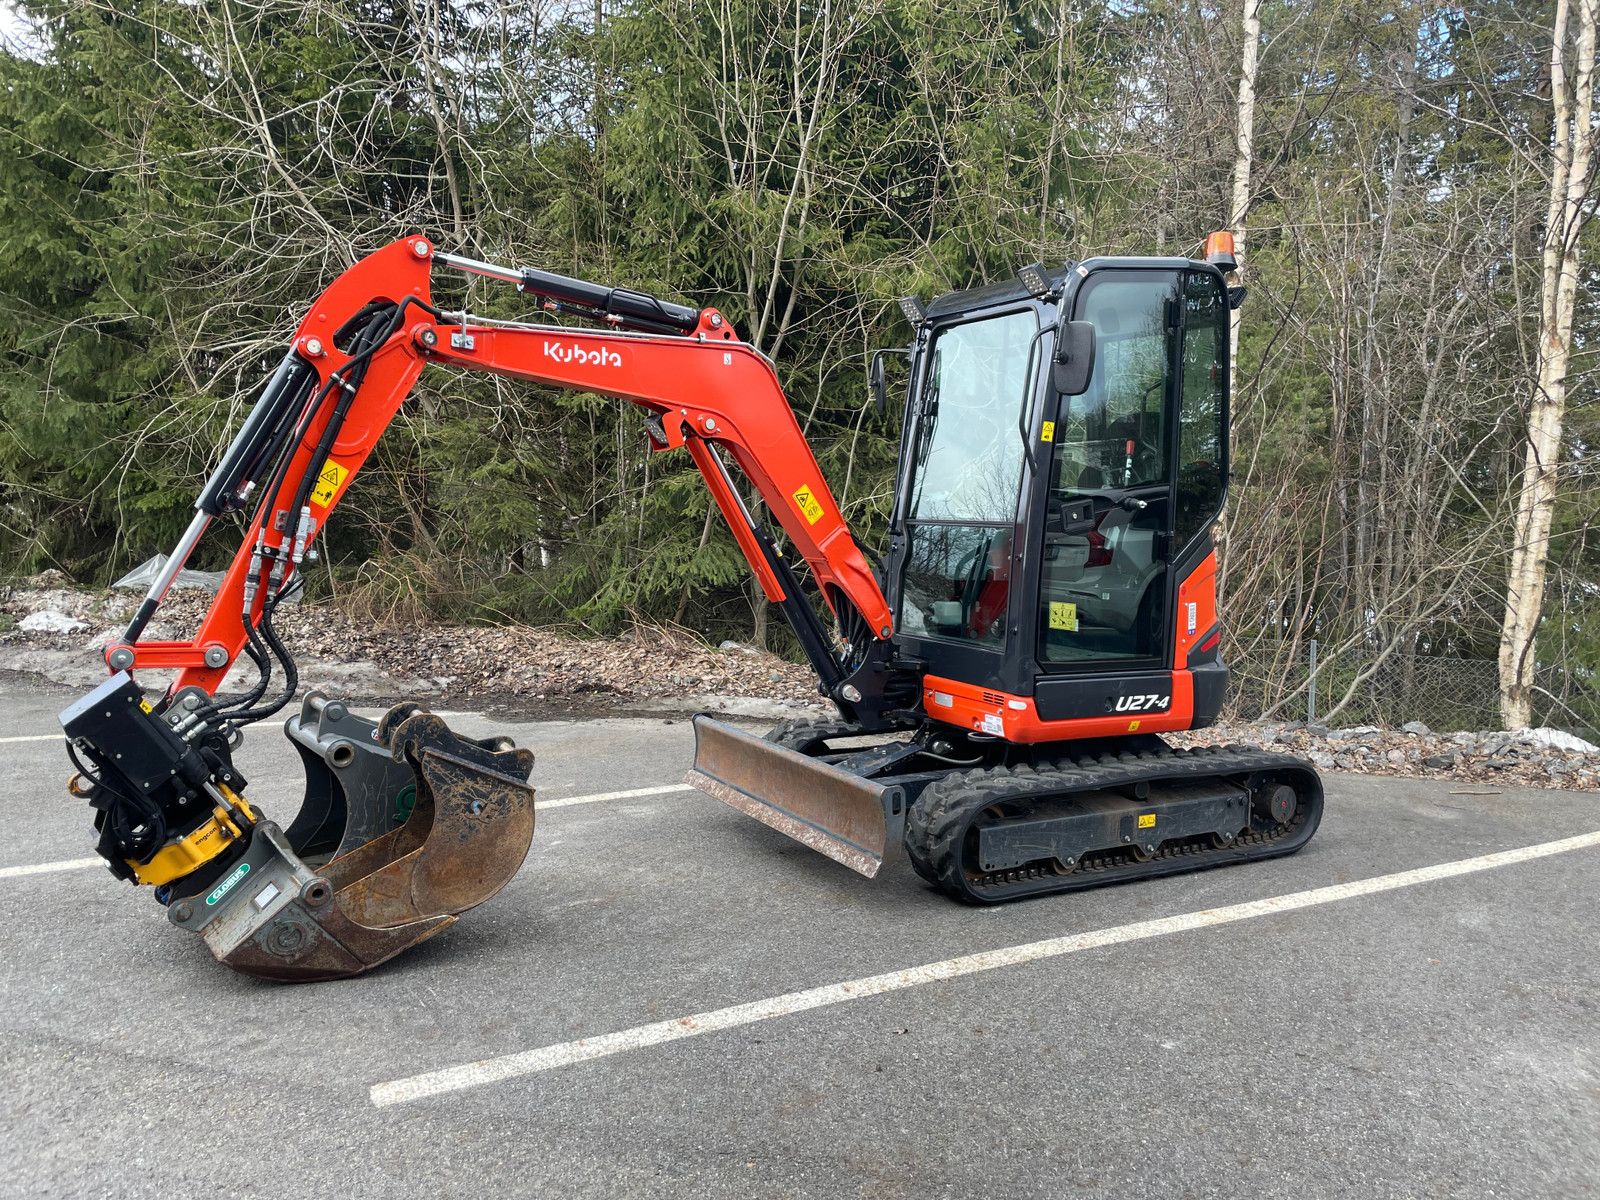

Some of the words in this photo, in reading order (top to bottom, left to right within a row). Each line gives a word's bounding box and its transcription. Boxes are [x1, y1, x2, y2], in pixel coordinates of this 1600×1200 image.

[543, 341, 622, 367] Kubota
[1115, 694, 1171, 711] U27-4
[195, 827, 218, 846] engcon
[212, 869, 245, 899] GLOBUS
